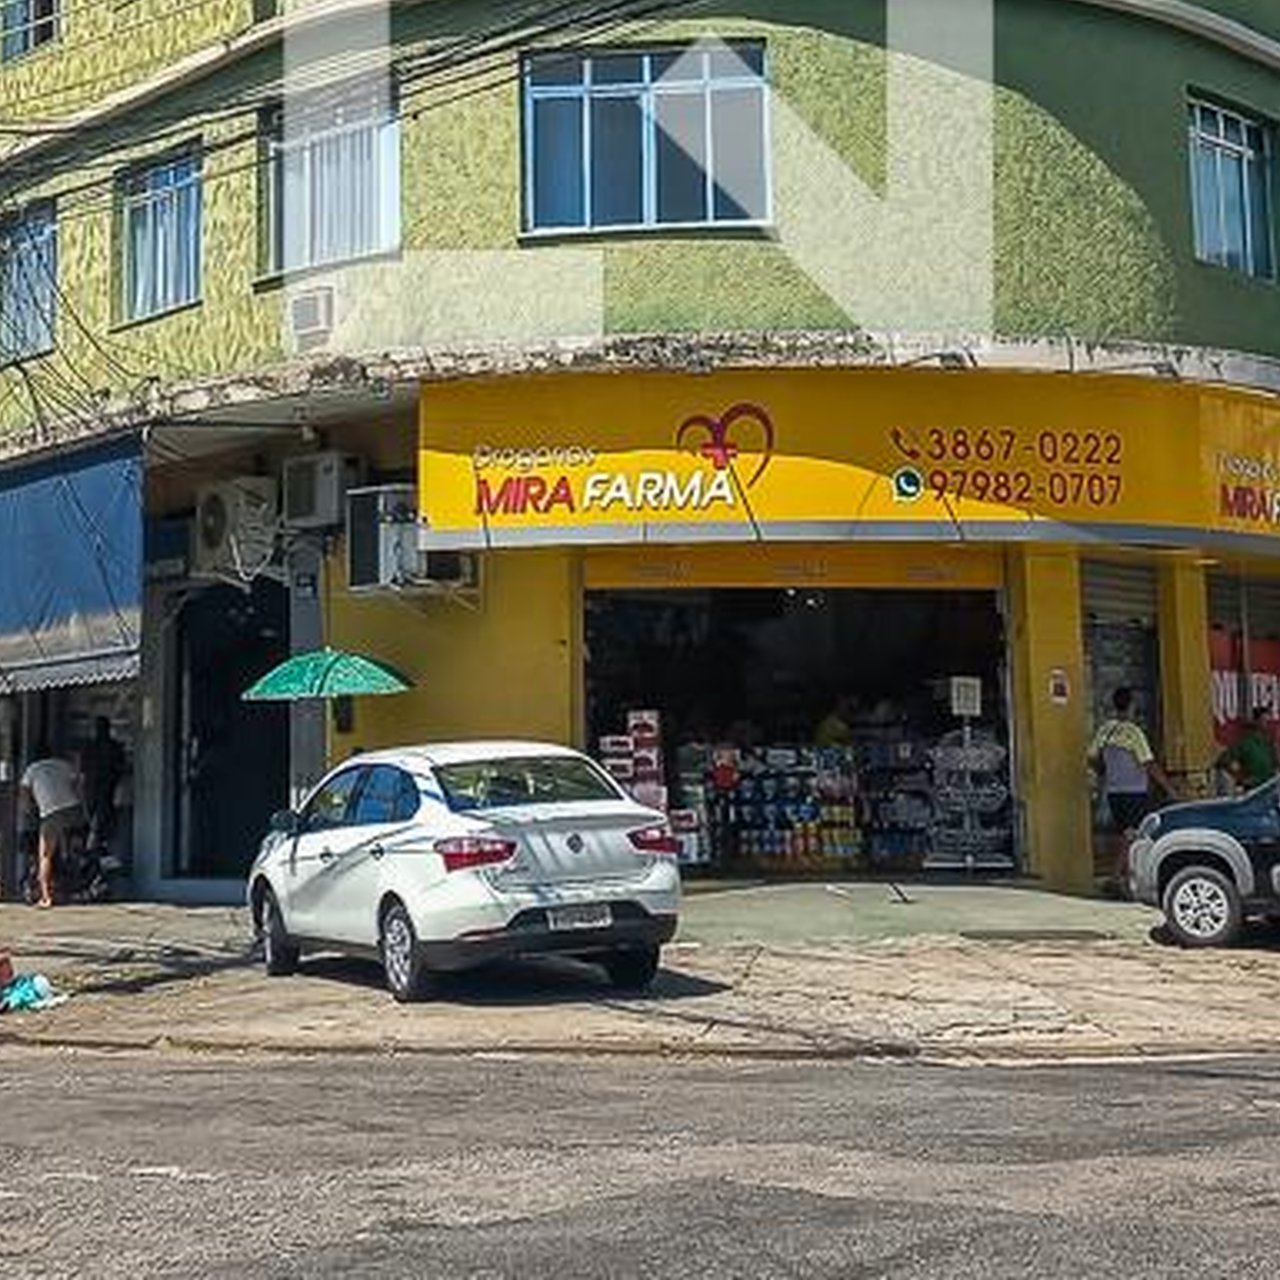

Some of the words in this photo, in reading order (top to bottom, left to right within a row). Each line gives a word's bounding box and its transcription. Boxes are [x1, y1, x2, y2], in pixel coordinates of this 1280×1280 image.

[928, 427, 1122, 465] 3867-0222
[475, 475, 575, 515] MIRA
[583, 470, 735, 511] FARMA
[928, 469, 1122, 505] 97982-0707
